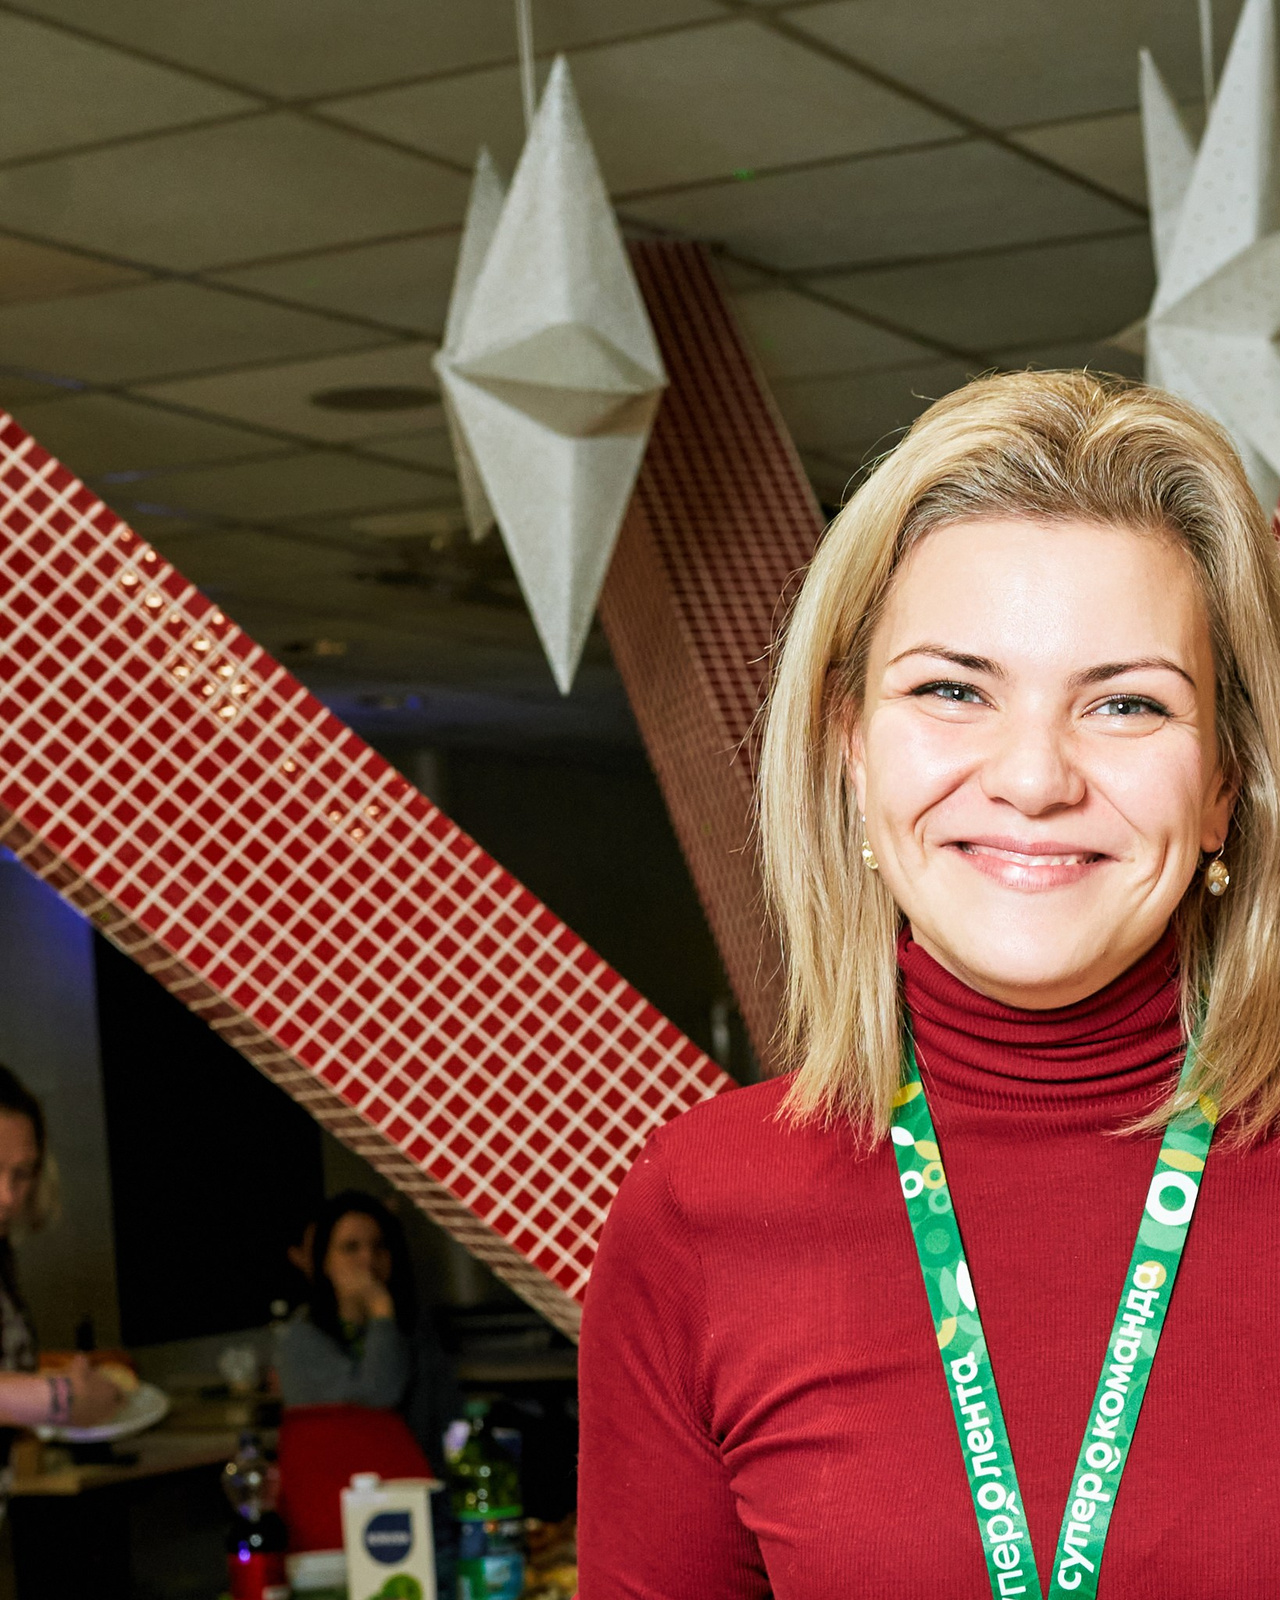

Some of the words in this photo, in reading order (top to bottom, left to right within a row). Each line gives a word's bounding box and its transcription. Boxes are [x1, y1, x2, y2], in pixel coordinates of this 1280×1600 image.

[950, 1351, 1002, 1478] лента
[1057, 1472, 1111, 1590] супер
[1092, 1264, 1160, 1440] команда
